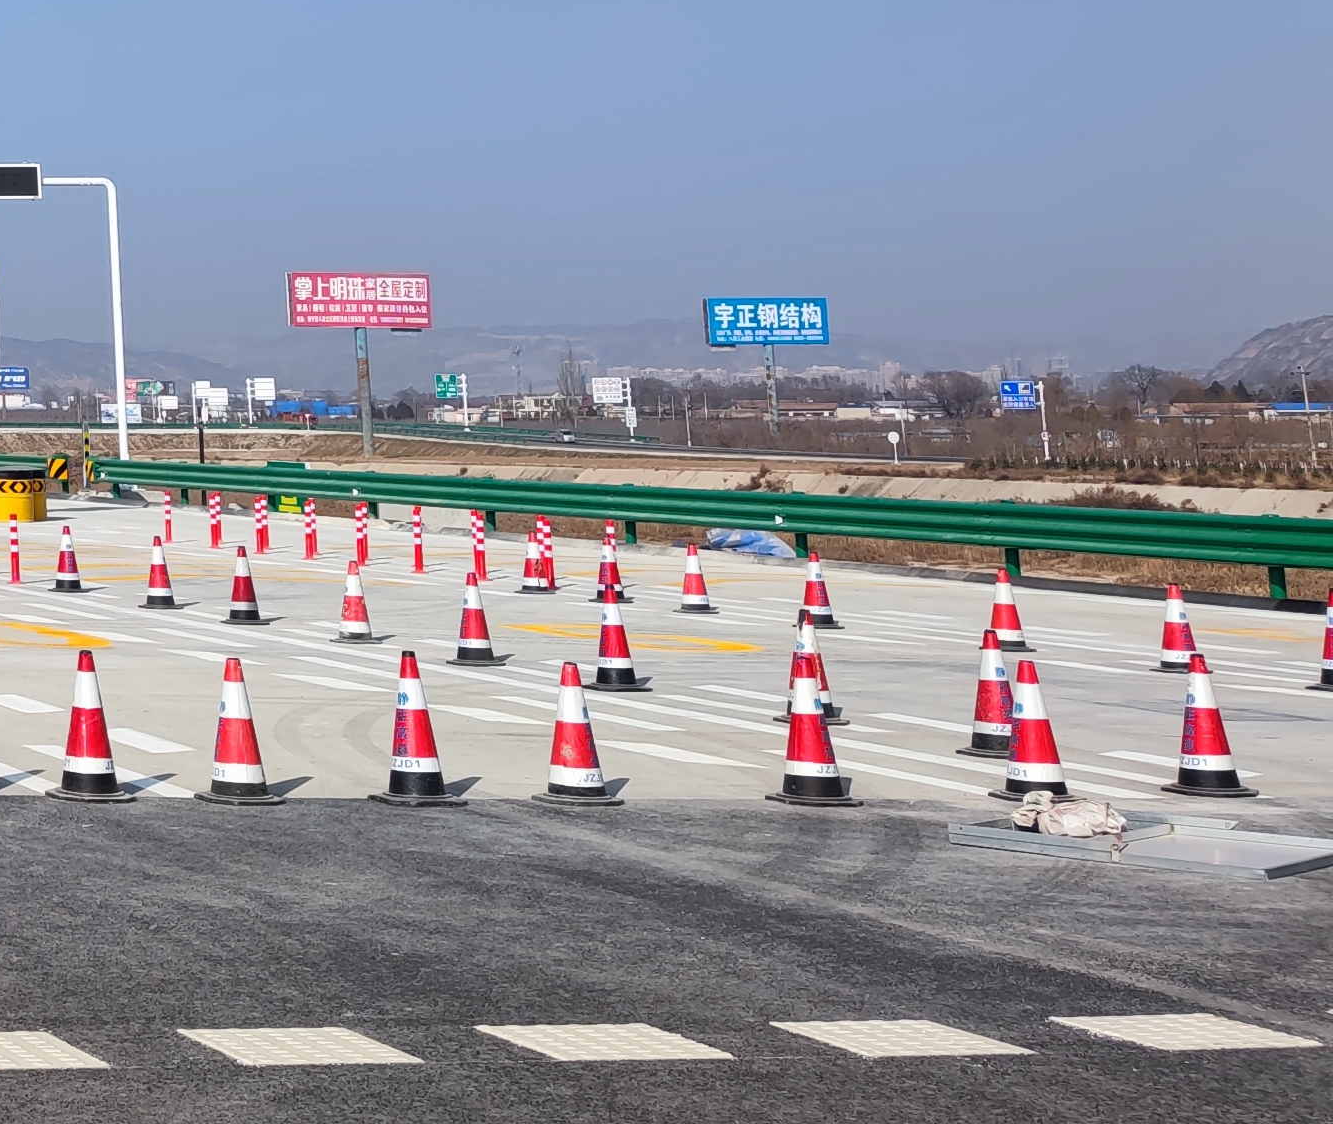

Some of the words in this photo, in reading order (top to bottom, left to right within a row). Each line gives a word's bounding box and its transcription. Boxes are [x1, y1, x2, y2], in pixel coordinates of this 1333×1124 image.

[294, 277, 366, 300] 掌上明珠
[379, 280, 426, 299] 全屋定制
[713, 303, 823, 328] 宇正钢结构
[1179, 756, 1208, 767] ZJD1
